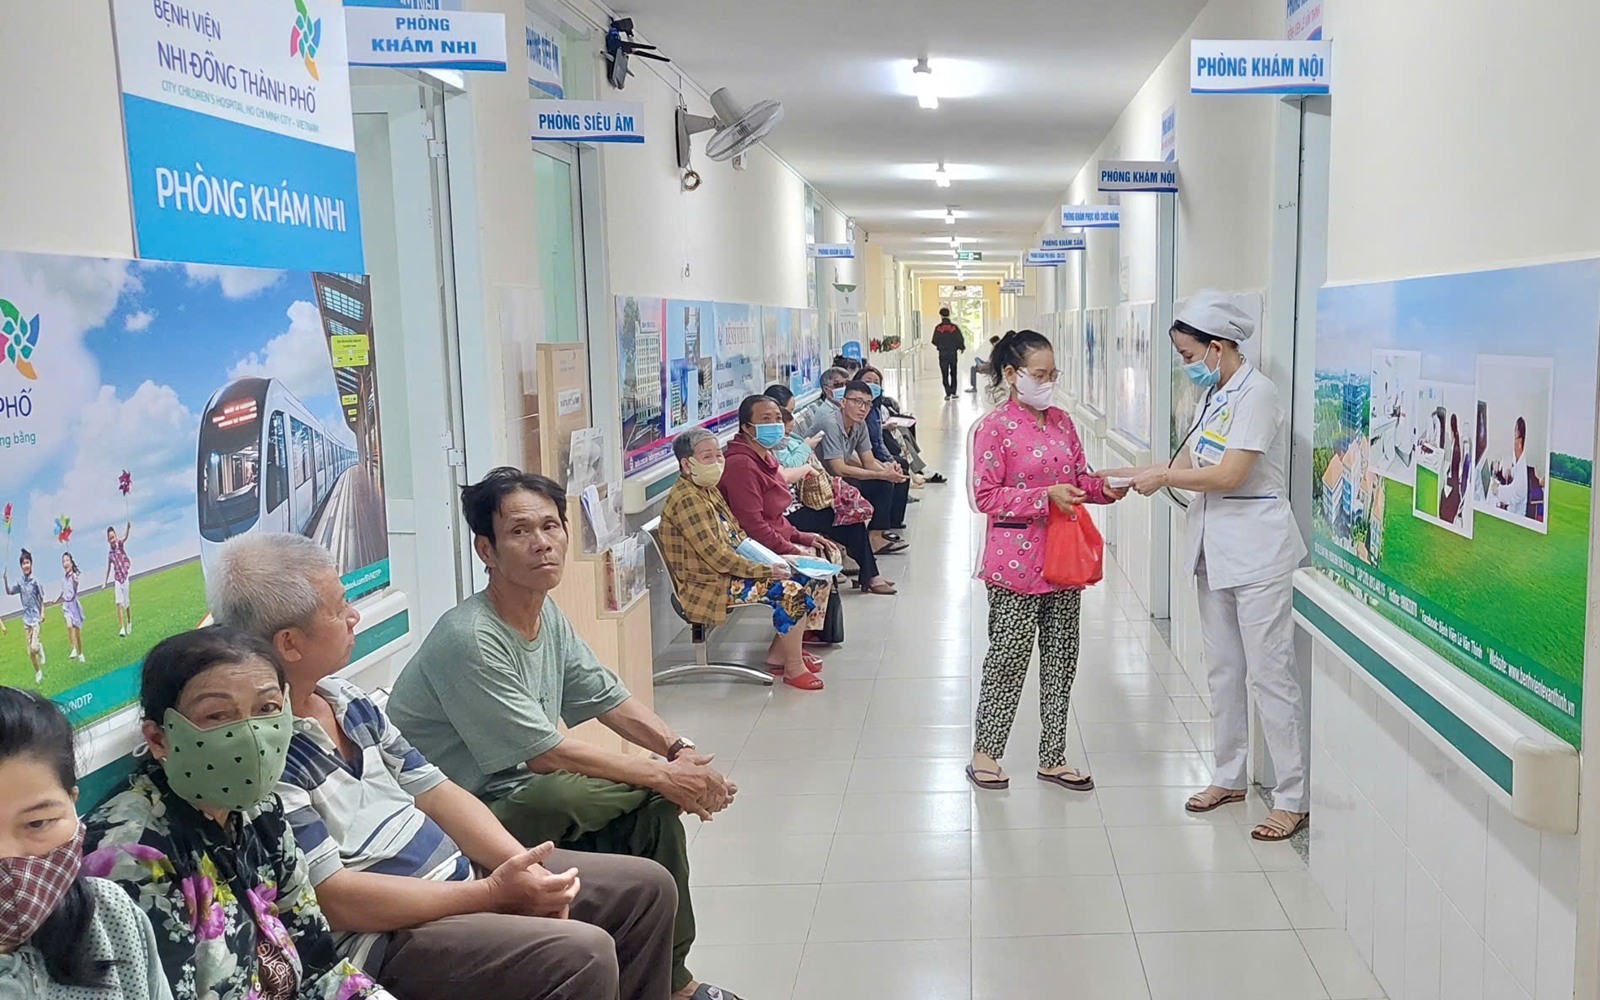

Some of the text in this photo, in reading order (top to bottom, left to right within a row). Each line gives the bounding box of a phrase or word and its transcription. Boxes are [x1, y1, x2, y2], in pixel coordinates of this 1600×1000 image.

[192, 12, 221, 41] VIỆN
[396, 15, 450, 32] PHÒNG
[372, 37, 477, 55] KHÁM NHI
[158, 41, 317, 113] NHI ĐỒNG THÀNH PHỐ
[1197, 52, 1324, 82] PHÒNG KHÁM NỘI
[161, 80, 177, 93] CITY
[265, 109, 280, 123] MINH
[280, 113, 292, 126] CITY
[538, 110, 635, 132] PHÒNG SIÊU ÂM
[1101, 168, 1176, 187] PHÒNG KHÁM NỘI
[155, 161, 347, 232] PHÒNG KHÁM NHI
[0, 387, 32, 418] PHỐ
[13, 430, 36, 445] bằng
